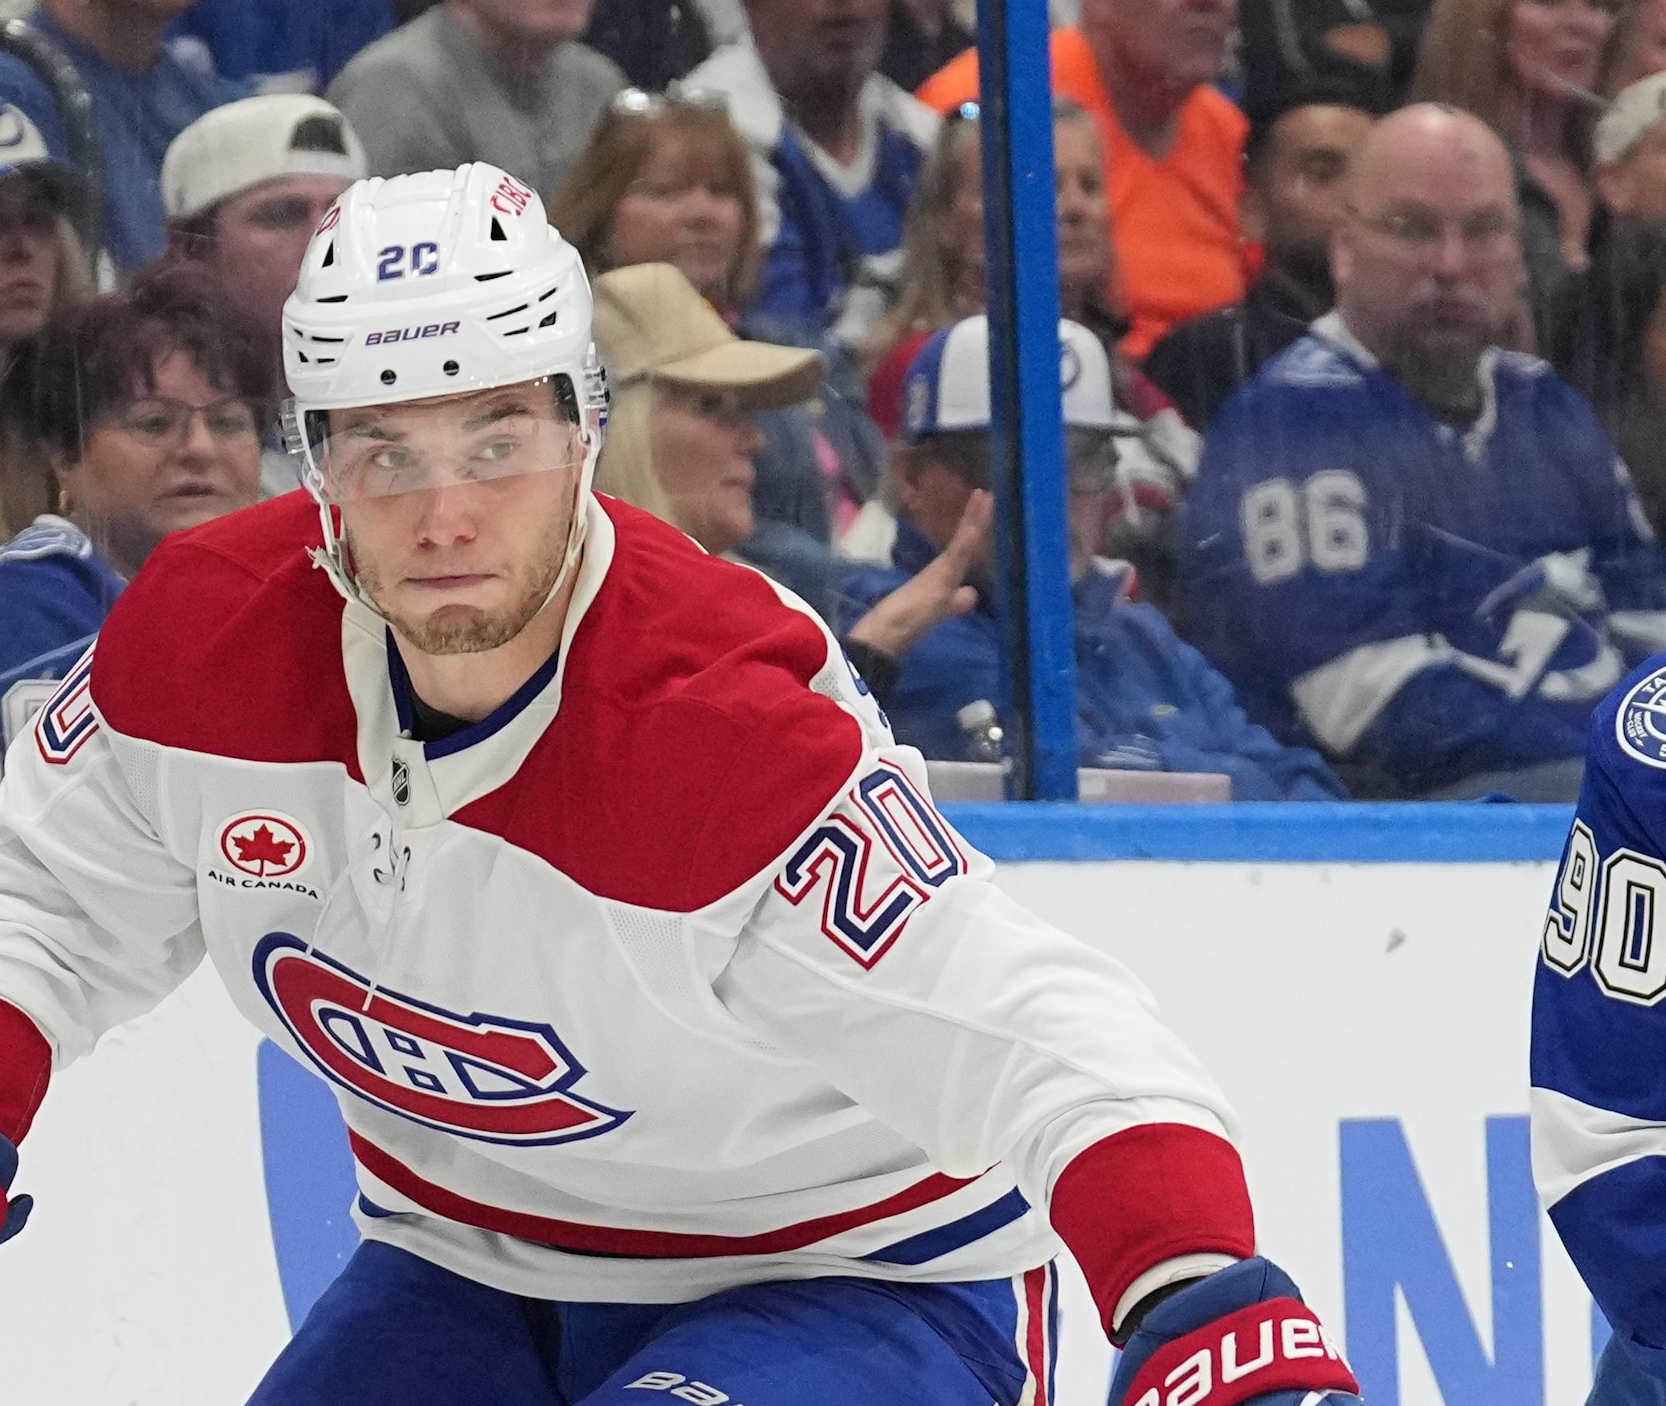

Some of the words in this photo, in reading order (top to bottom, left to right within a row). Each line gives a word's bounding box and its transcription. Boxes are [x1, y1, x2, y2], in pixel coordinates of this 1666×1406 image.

[364, 320, 461, 347] BAUER
[1239, 469, 1370, 585] 86
[208, 870, 236, 888] AIR
[241, 879, 319, 901] CANADA
[774, 757, 969, 972] 20
